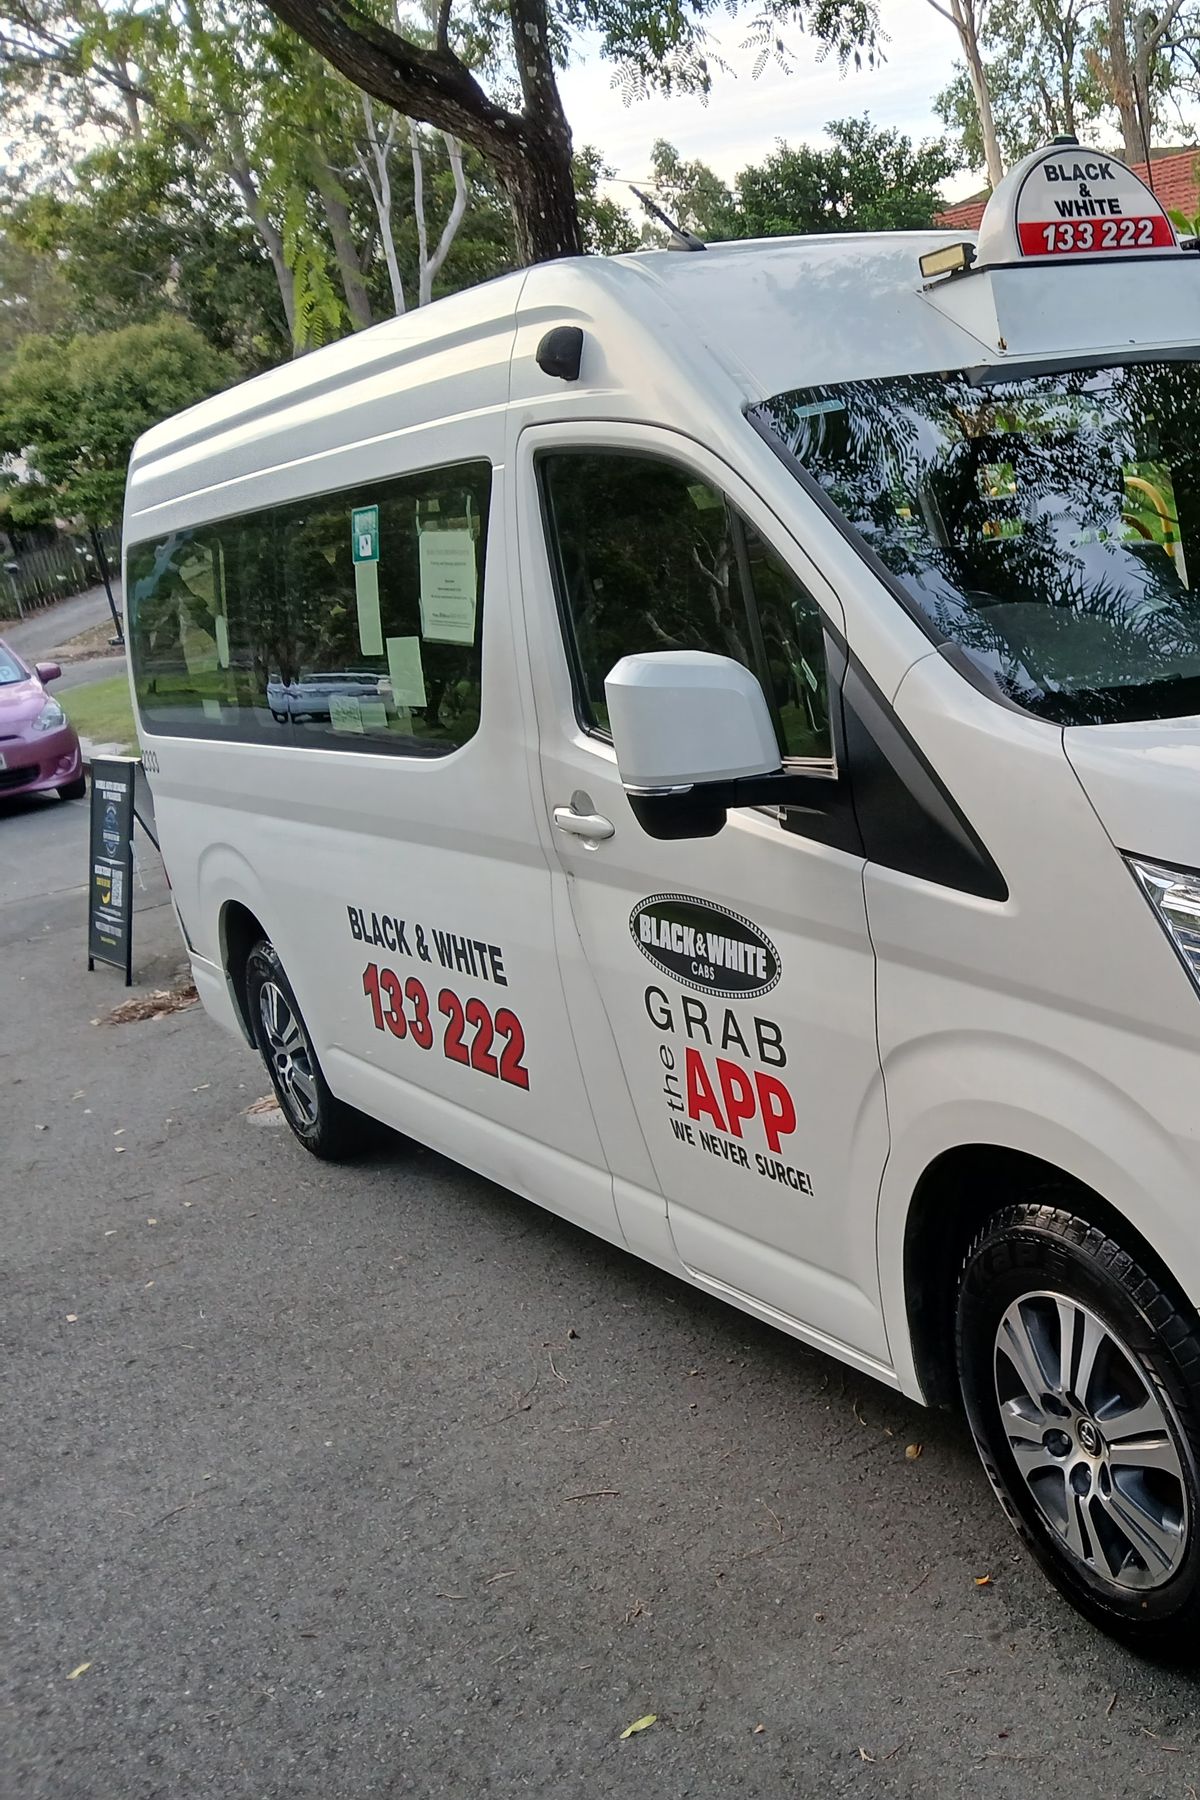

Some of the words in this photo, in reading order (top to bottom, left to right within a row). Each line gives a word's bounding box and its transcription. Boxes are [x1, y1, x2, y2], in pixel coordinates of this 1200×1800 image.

[1044, 163, 1115, 182] BLACK
[1079, 182, 1092, 198] &
[1043, 221, 1095, 251] 133
[1101, 219, 1154, 248] 222
[1054, 198, 1122, 217] WHITE
[347, 905, 413, 957] BLACK
[415, 924, 432, 963] &
[431, 928, 508, 987] WHITE
[691, 961, 715, 981] CABS
[362, 962, 434, 1050] 133
[438, 988, 530, 1091] 222
[644, 985, 788, 1068] GRAB
[659, 1044, 685, 1112] the
[685, 1046, 797, 1155] APP
[669, 1117, 696, 1146] WE
[698, 1129, 751, 1170] NEVER
[755, 1153, 814, 1197] SURGE!
